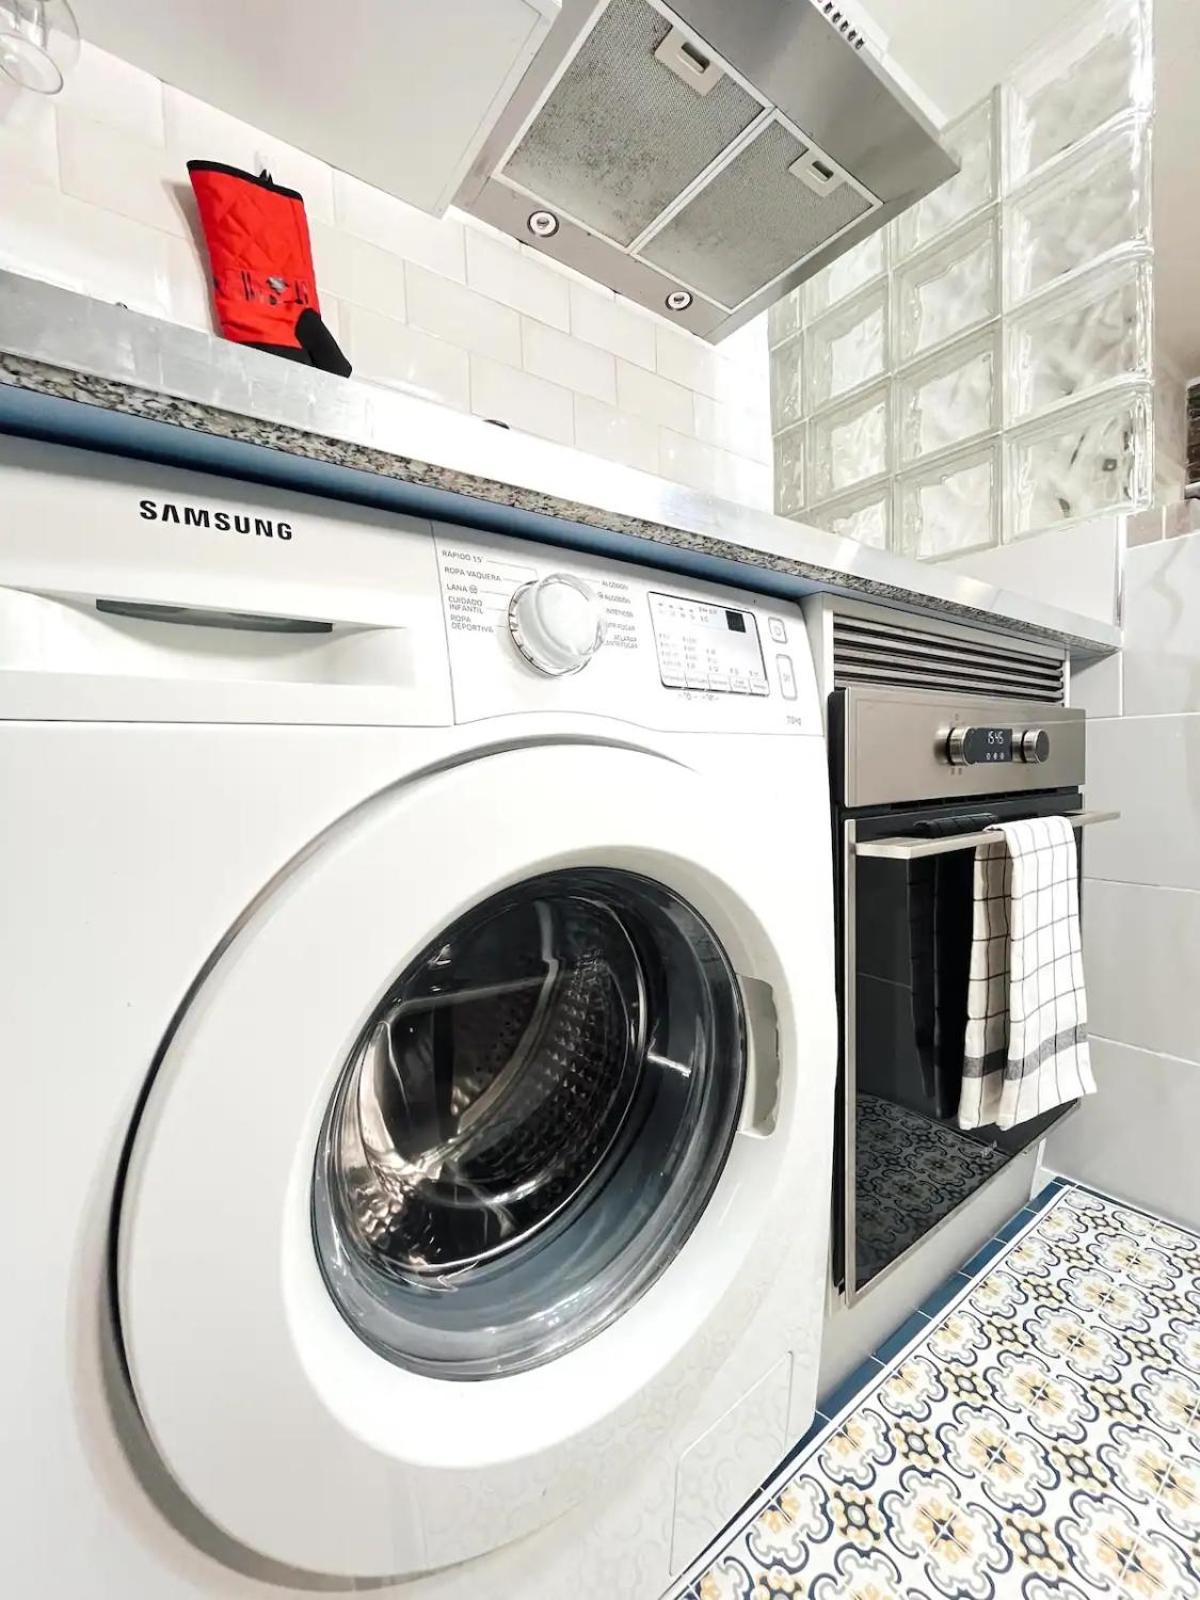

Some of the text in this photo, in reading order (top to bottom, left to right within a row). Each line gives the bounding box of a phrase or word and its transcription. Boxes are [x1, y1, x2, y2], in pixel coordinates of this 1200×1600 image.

[139, 500, 293, 541] SAMSUNG
[444, 566, 502, 583] ROPA VAQUERA
[446, 583, 468, 593] LANA
[448, 595, 483, 607] CUIDADO
[449, 603, 483, 615] INFANTIL
[450, 614, 471, 623] ROPA
